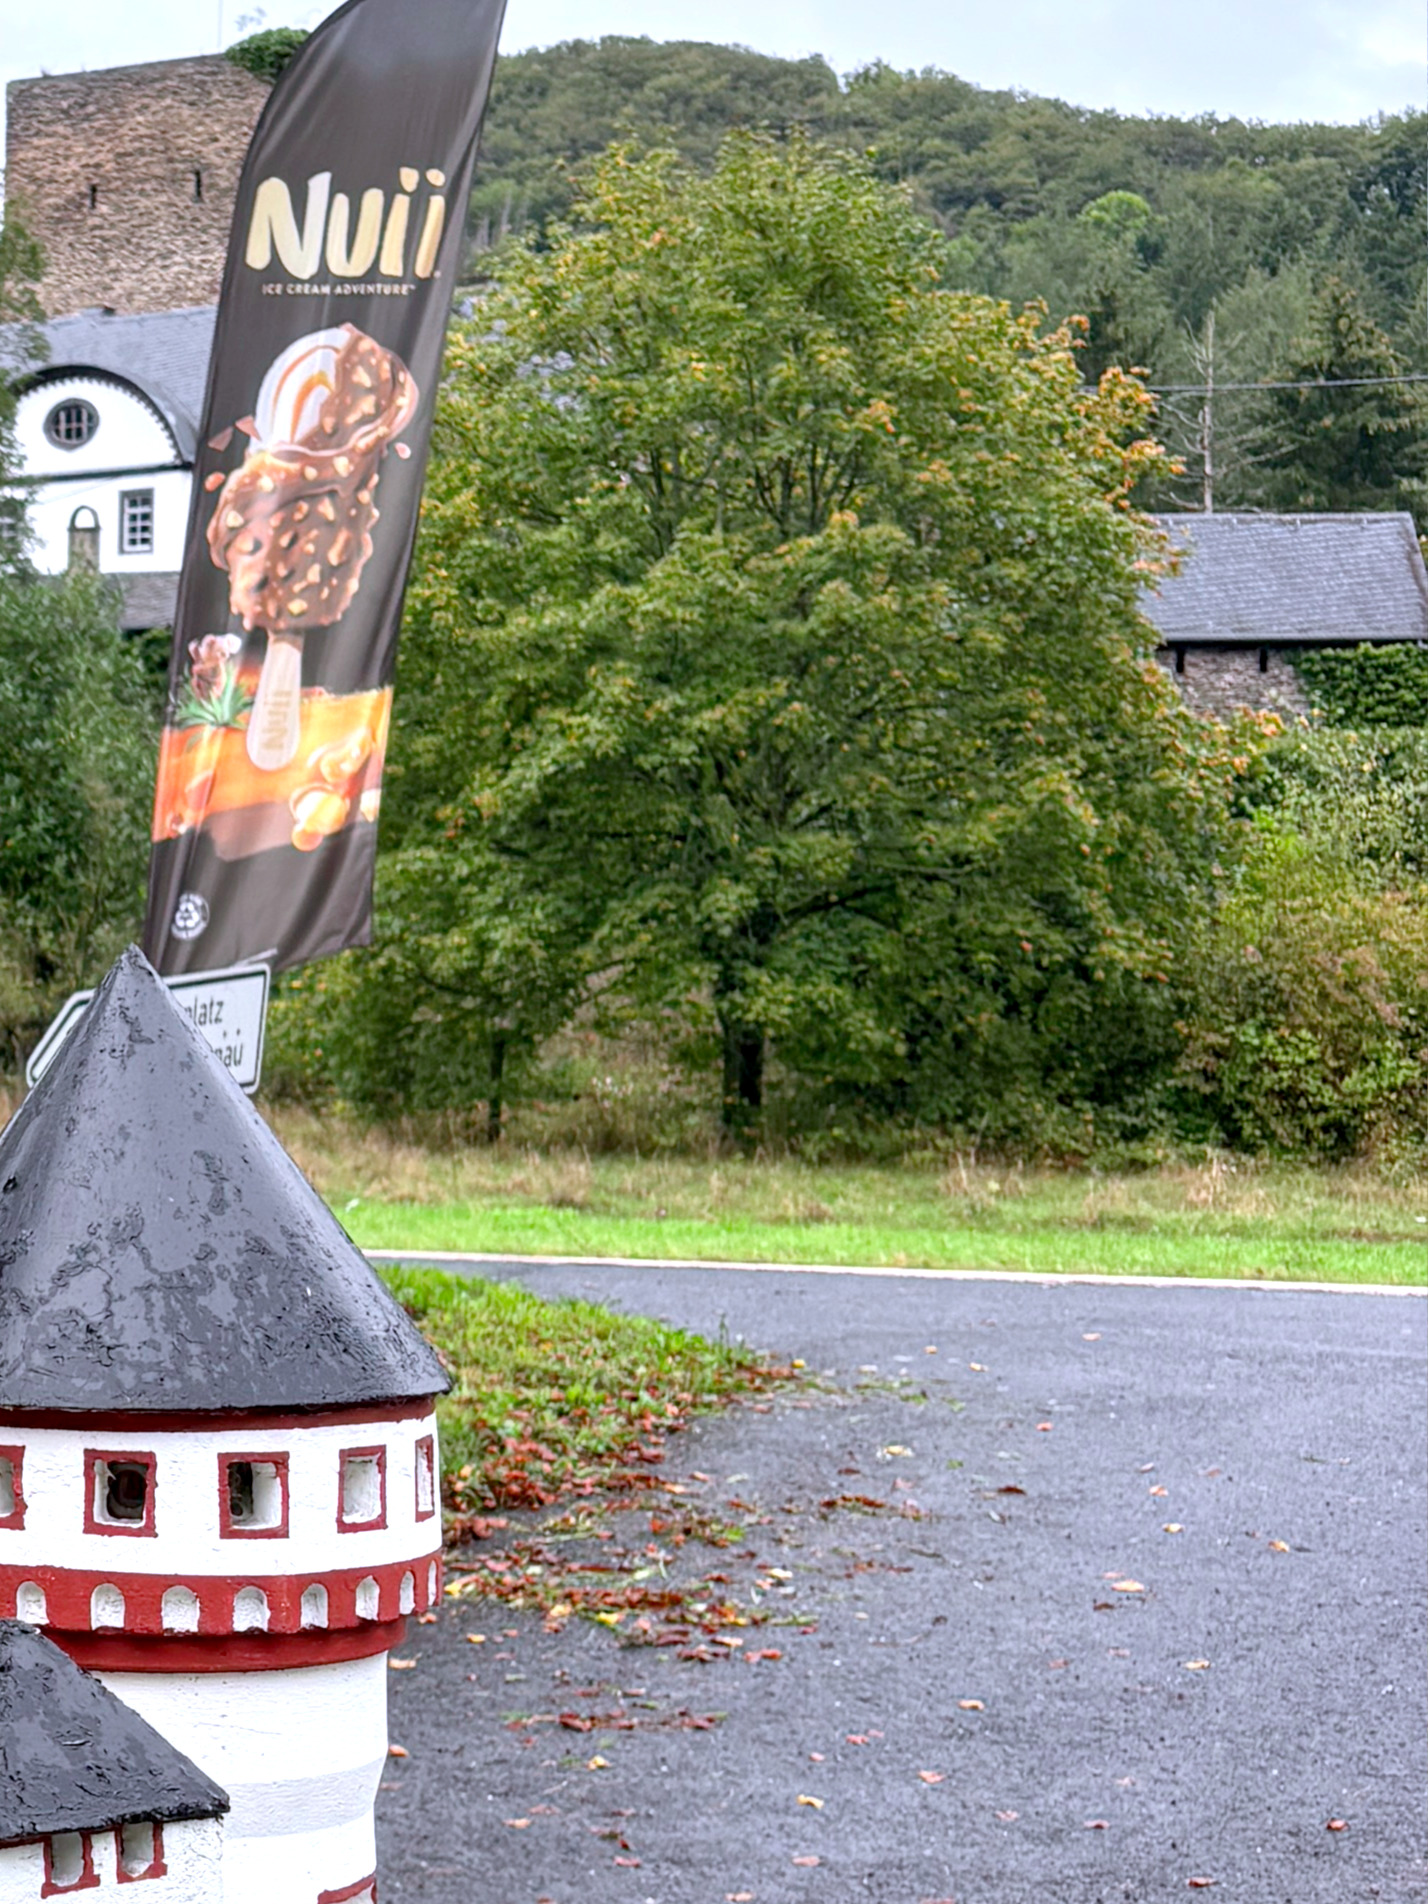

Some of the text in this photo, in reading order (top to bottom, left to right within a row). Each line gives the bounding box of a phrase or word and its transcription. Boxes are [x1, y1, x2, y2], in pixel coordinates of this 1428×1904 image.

[245, 166, 445, 280] Nuii
[262, 282, 282, 296] ICE
[286, 282, 331, 296] CREAM
